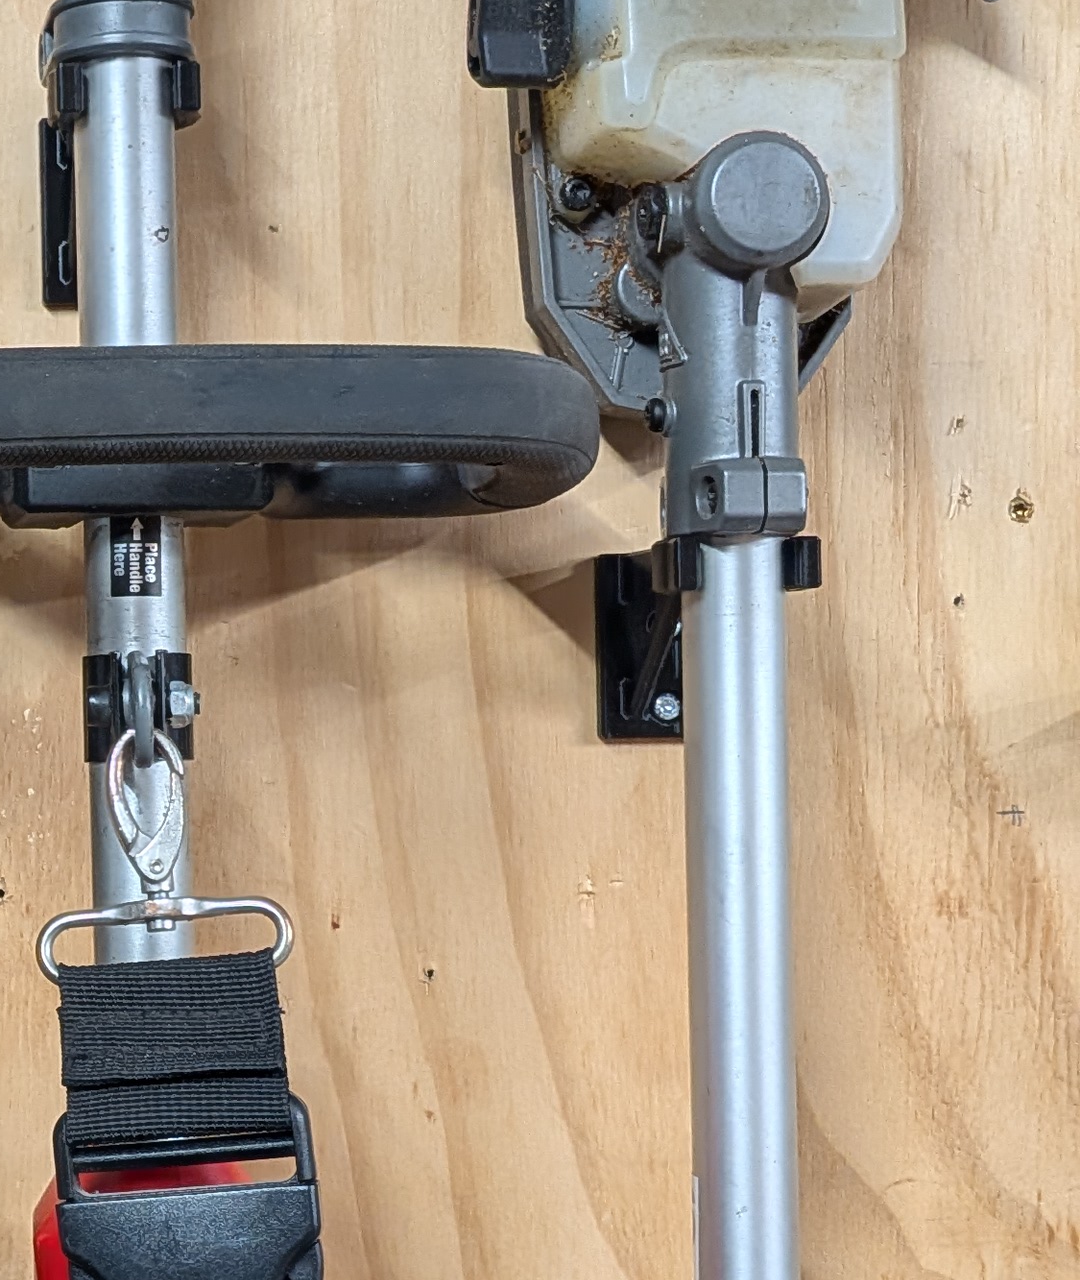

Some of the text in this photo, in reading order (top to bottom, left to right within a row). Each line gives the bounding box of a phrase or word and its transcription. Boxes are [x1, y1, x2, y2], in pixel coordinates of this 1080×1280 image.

[113, 542, 127, 577] Here
[128, 542, 144, 593] Handle
[144, 542, 159, 583] Place
